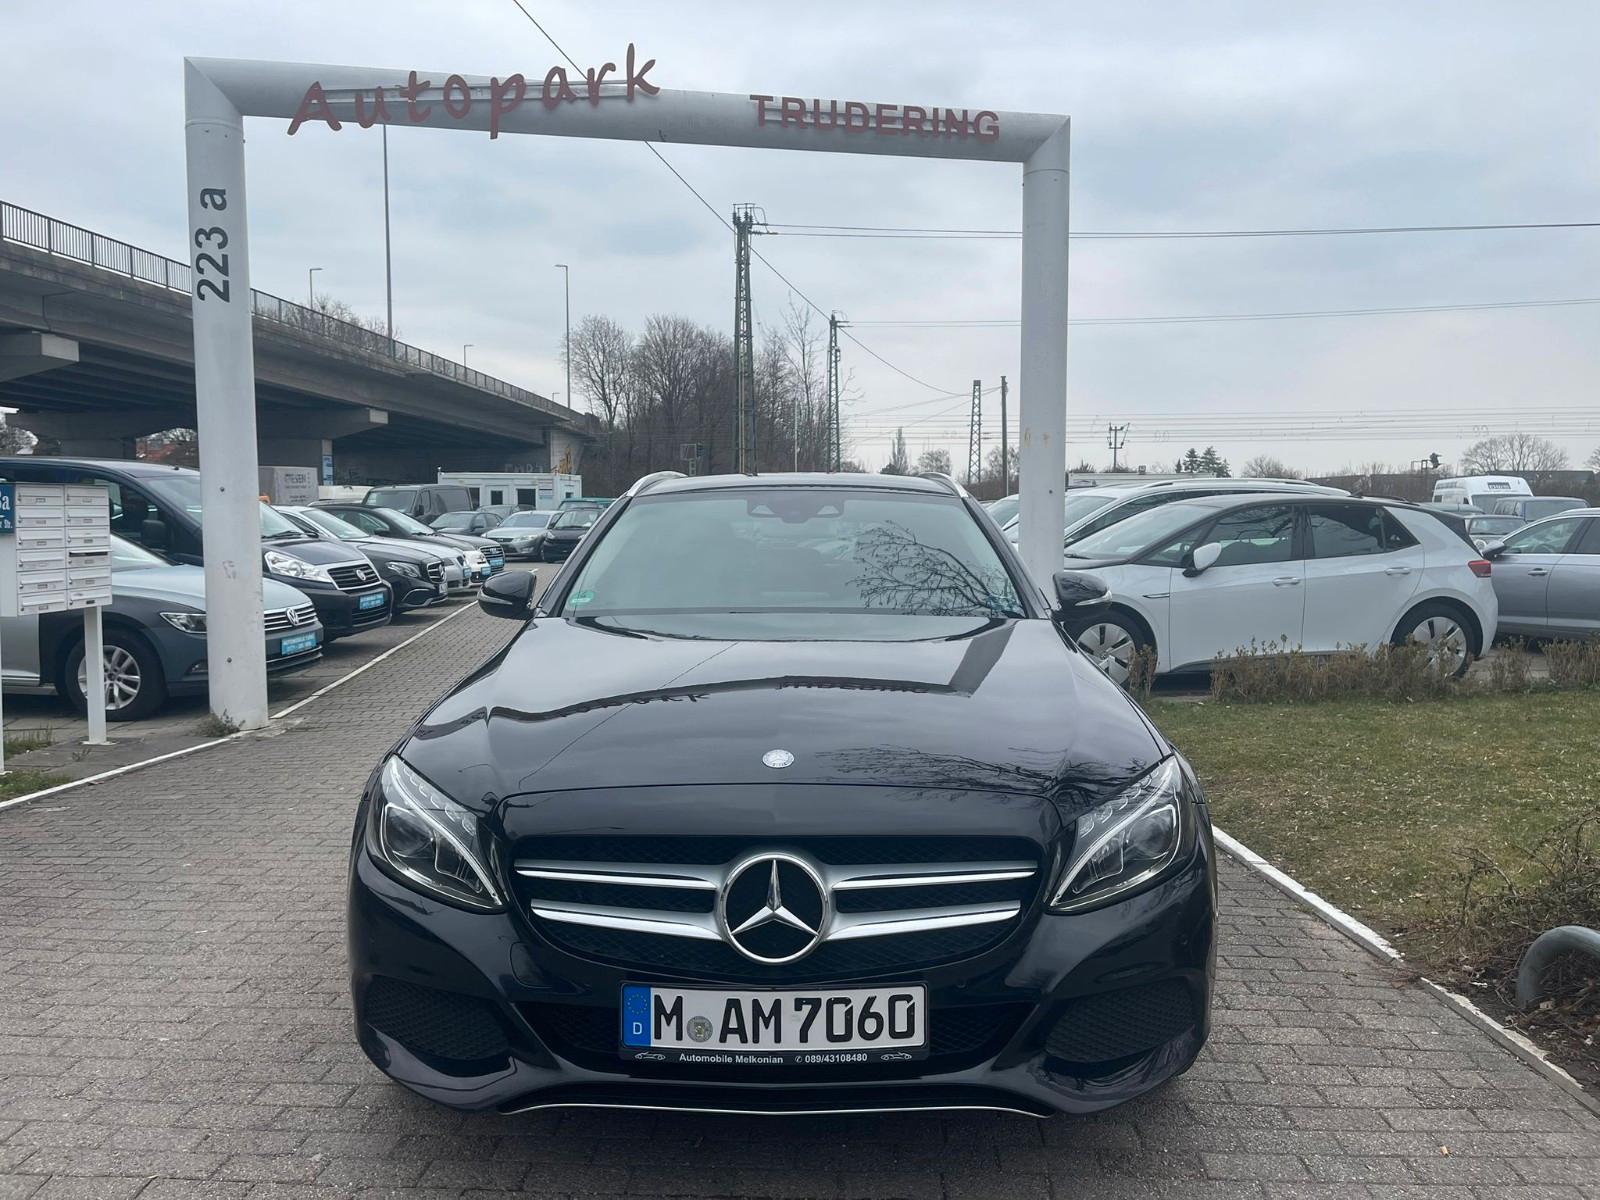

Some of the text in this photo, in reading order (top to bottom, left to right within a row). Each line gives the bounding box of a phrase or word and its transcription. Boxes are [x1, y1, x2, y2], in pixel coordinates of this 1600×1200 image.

[287, 43, 660, 138] Autopark
[750, 94, 1000, 143] TRUDERING
[195, 188, 230, 304] 223 a
[633, 1022, 643, 1035] D
[653, 994, 684, 1041] M
[719, 998, 782, 1044] AM
[794, 994, 915, 1044] 7060
[679, 1053, 868, 1064] Automobile Melkonian 089/43108480
